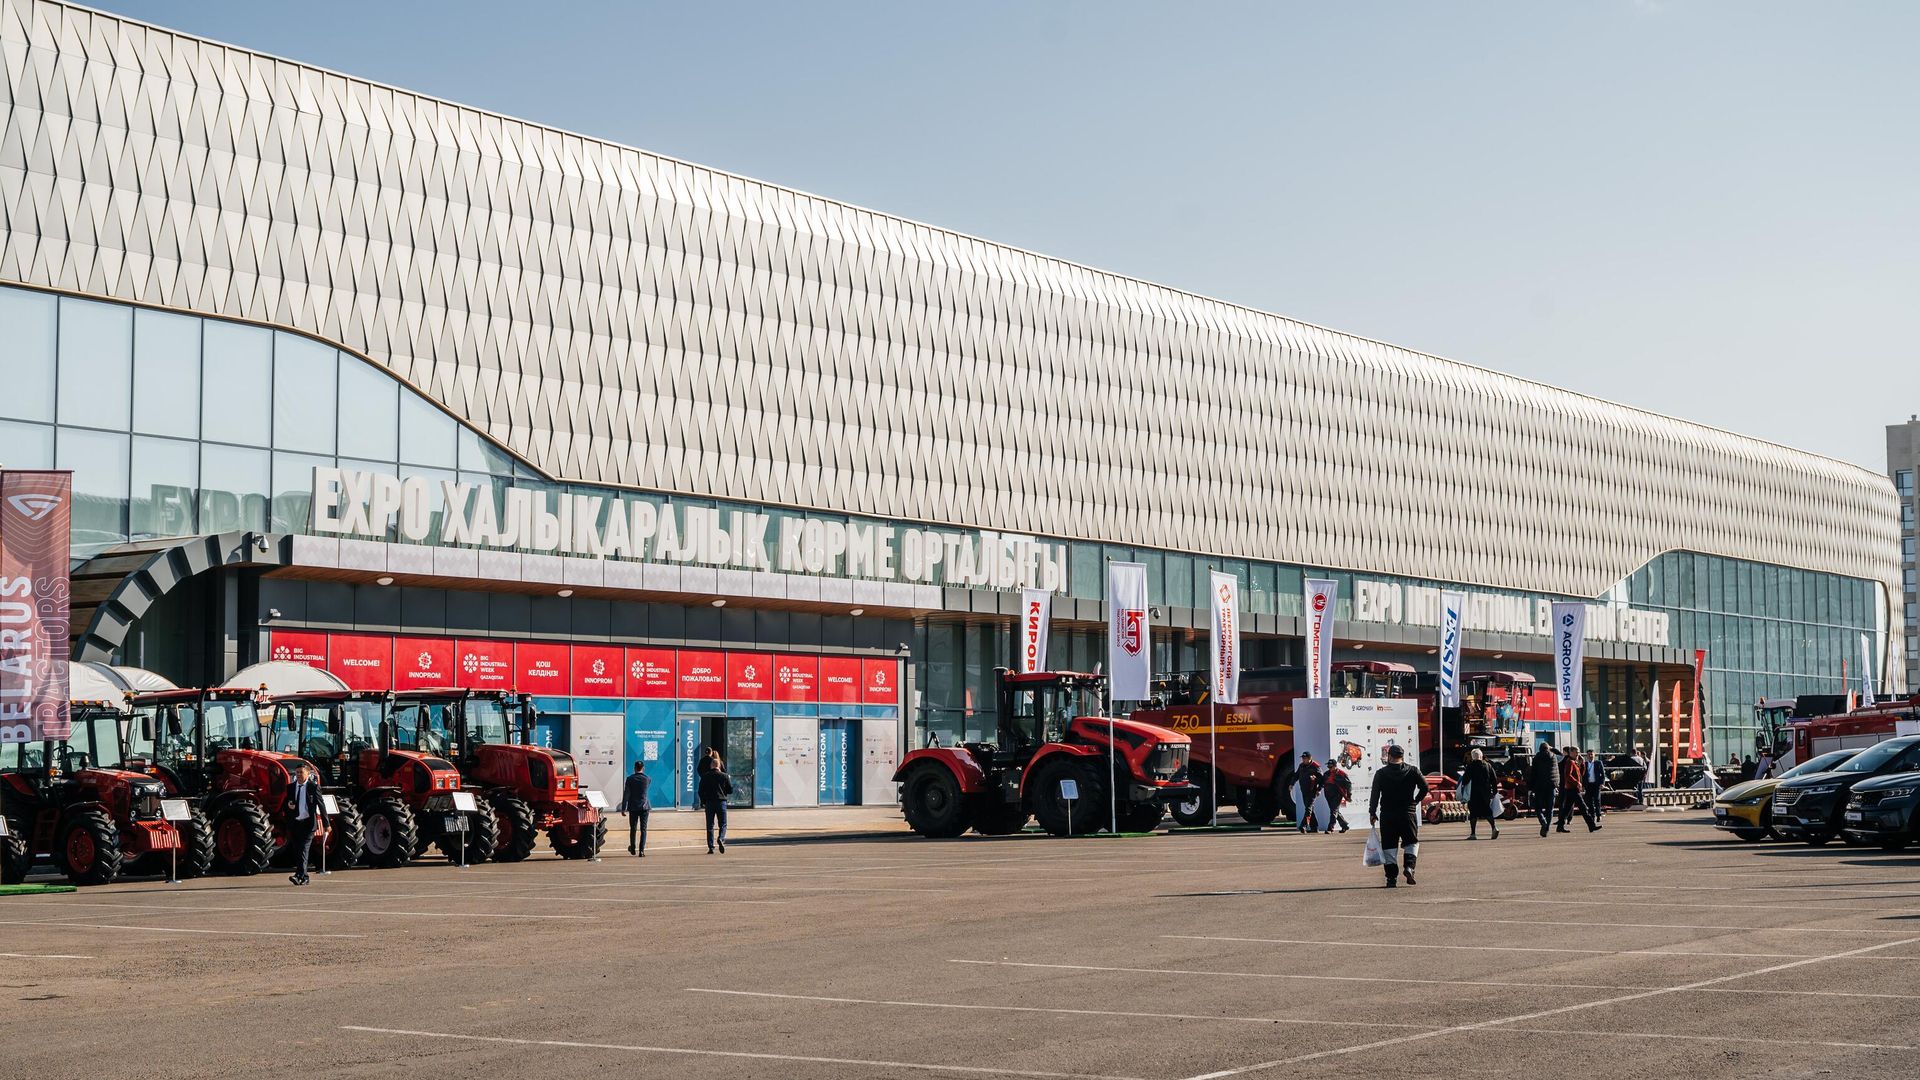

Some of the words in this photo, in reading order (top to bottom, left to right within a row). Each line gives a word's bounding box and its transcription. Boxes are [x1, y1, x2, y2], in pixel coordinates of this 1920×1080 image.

[312, 466, 430, 540] EXPO
[440, 480, 771, 573] ХАЛЫҚАРАЛЫҚ
[1354, 580, 1402, 623] EXPO
[0, 576, 32, 743] BELARUS
[34, 576, 70, 742] TRACTORS
[343, 658, 380, 667] WELCOME!
[1027, 602, 1041, 671] КИРОВ
[1562, 631, 1572, 701] AGROMASH
[1172, 714, 1200, 730] 750
[1225, 712, 1253, 724] ESSIL
[1377, 727, 1398, 735] КИРОВЕЦ
[686, 730, 694, 791] INNOPROM
